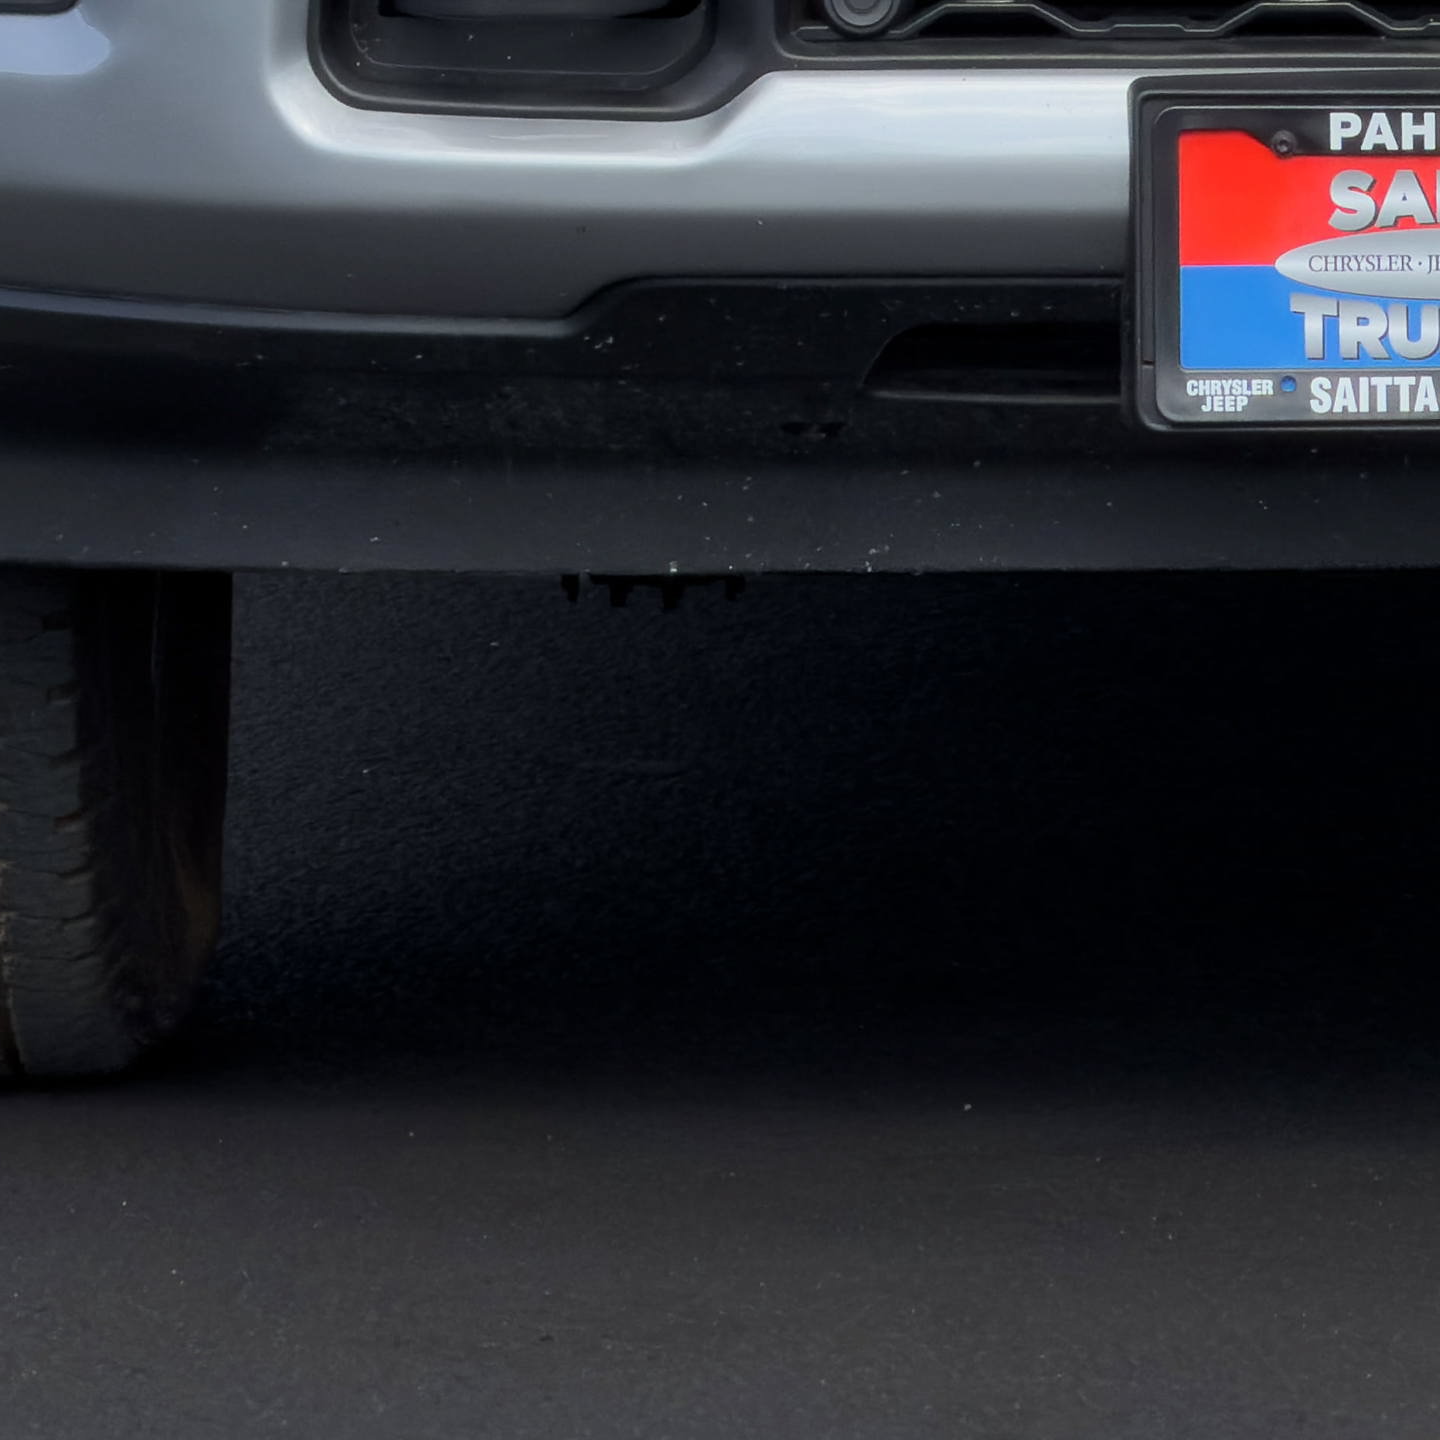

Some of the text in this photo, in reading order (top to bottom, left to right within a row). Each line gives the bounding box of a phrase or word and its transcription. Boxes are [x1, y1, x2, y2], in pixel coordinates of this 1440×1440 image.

[1308, 253, 1414, 272] CHRYSLER
[1186, 378, 1274, 397] CHRYSLER
[1201, 395, 1248, 412] JEEP
